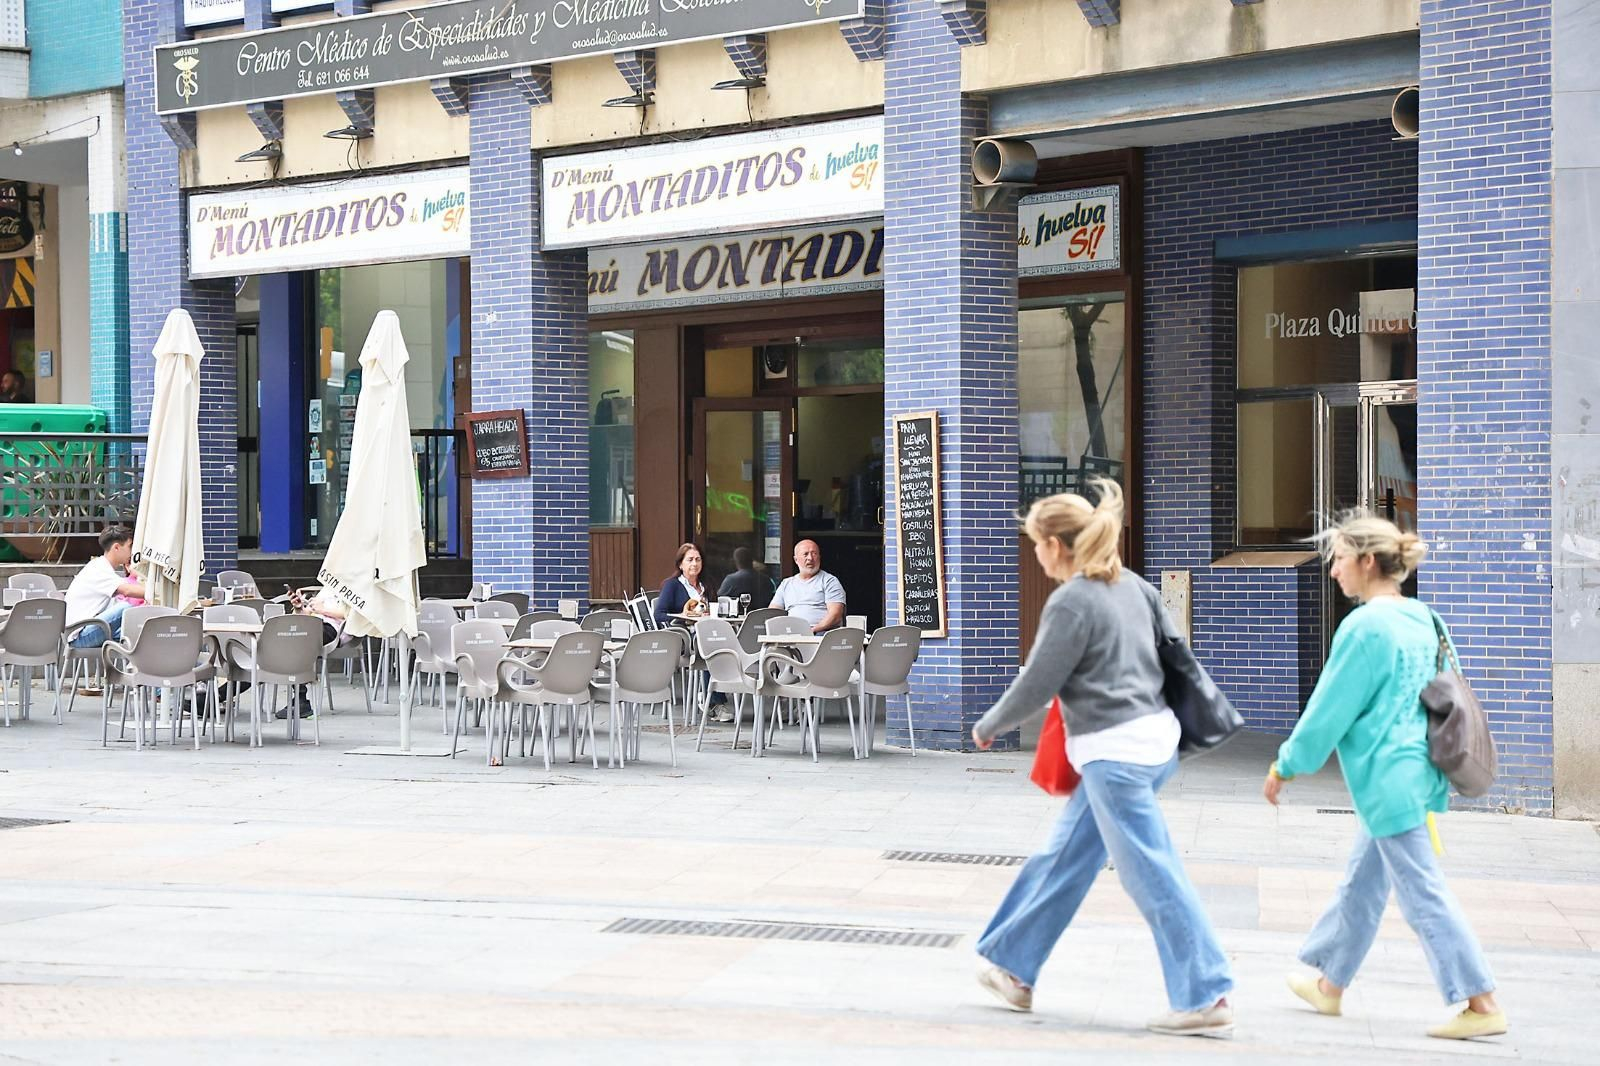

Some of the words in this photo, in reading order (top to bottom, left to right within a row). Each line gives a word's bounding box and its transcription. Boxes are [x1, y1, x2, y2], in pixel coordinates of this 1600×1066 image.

[237, 42, 291, 76] Centro
[297, 28, 367, 67] Médico
[372, 23, 393, 57] de
[400, 4, 529, 60] Especialidades
[530, 10, 546, 44] y
[572, 20, 669, 49] orosalud@orosalud.es
[442, 44, 510, 67] www.orosalud.es
[297, 70, 313, 88] Tel.
[316, 71, 331, 86] 621
[334, 67, 352, 84] 066
[353, 65, 370, 82] 644
[567, 146, 806, 229] MONTADITOS
[825, 142, 879, 180] huelva
[210, 191, 407, 260] MONTADITOS
[422, 189, 466, 223] huelva
[1035, 202, 1107, 248] huelva
[1264, 311, 1320, 339] Plaza
[1327, 305, 1418, 339] Quintero
[900, 422, 917, 433] PARA
[904, 433, 930, 446] LLEVAR
[902, 520, 933, 531] COSTILLAS
[908, 531, 926, 541] BBQ
[904, 572, 934, 585] PEPITOS
[339, 585, 366, 610] PRISA
